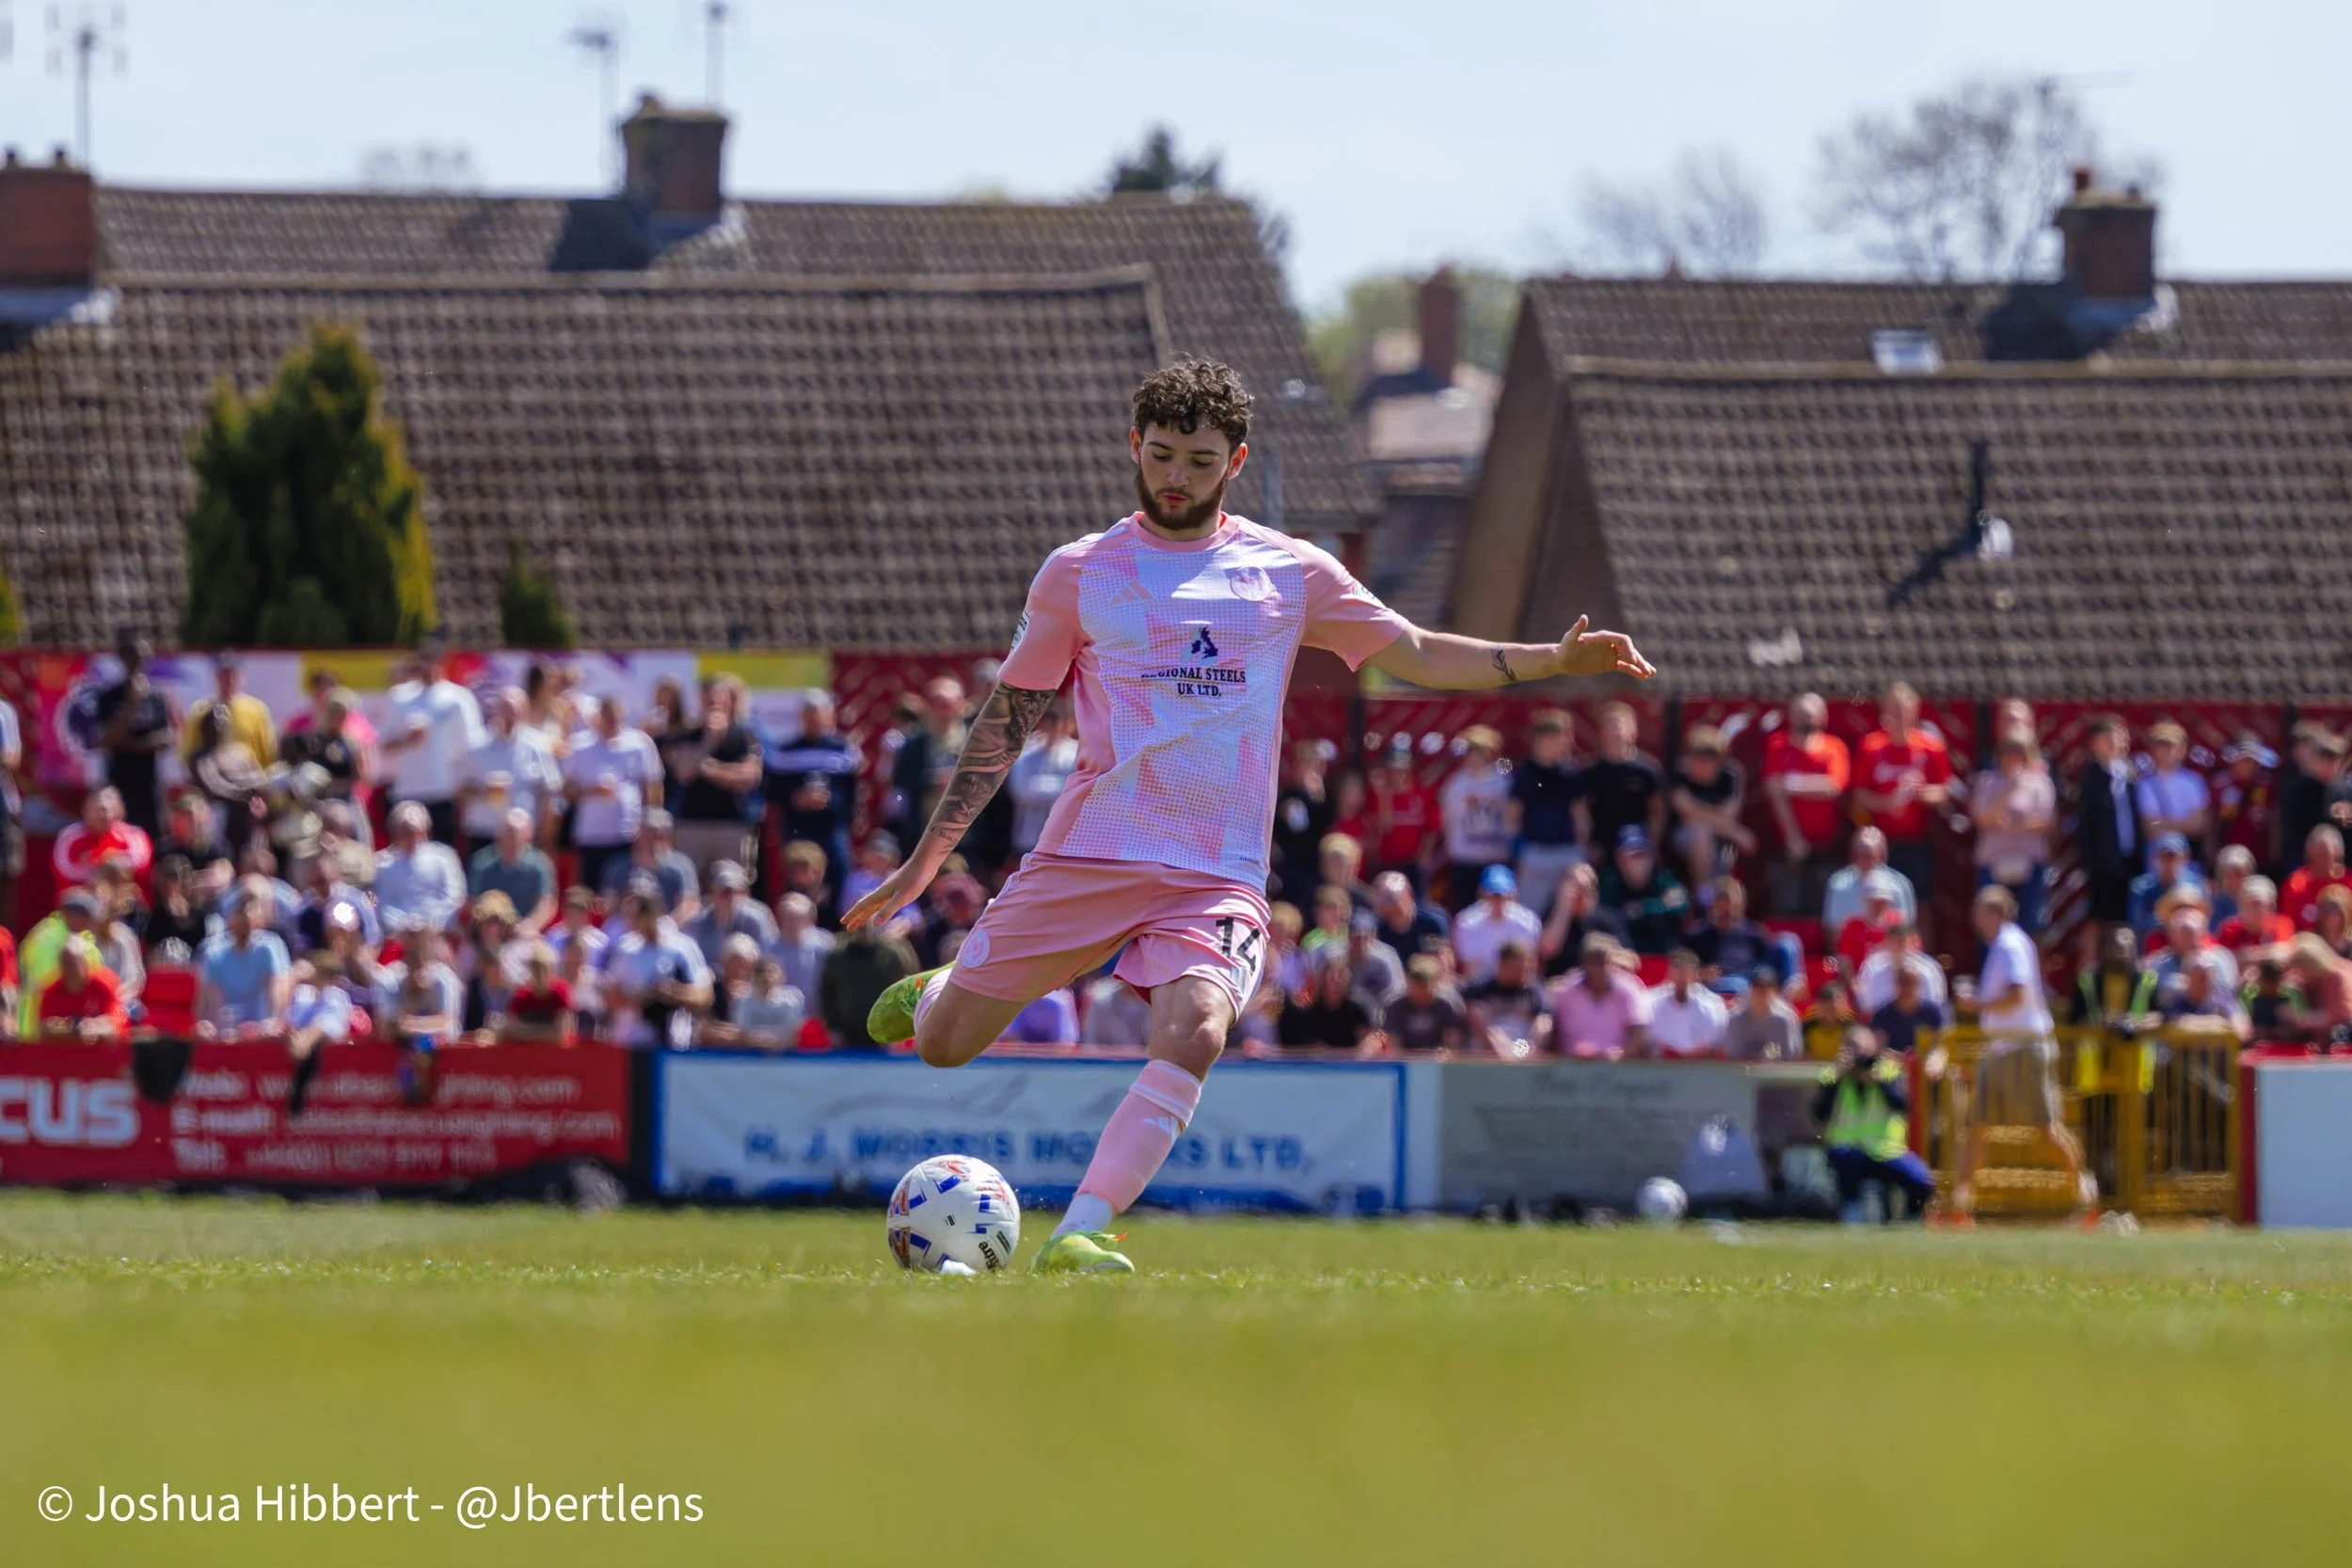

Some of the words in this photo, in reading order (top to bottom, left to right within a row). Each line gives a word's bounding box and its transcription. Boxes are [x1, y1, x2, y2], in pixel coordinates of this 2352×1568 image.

[1140, 667, 1202, 679] GIONAL
[1205, 668, 1247, 683] STEELS
[1177, 683, 1195, 695] UK
[1216, 916, 1261, 976] 14
